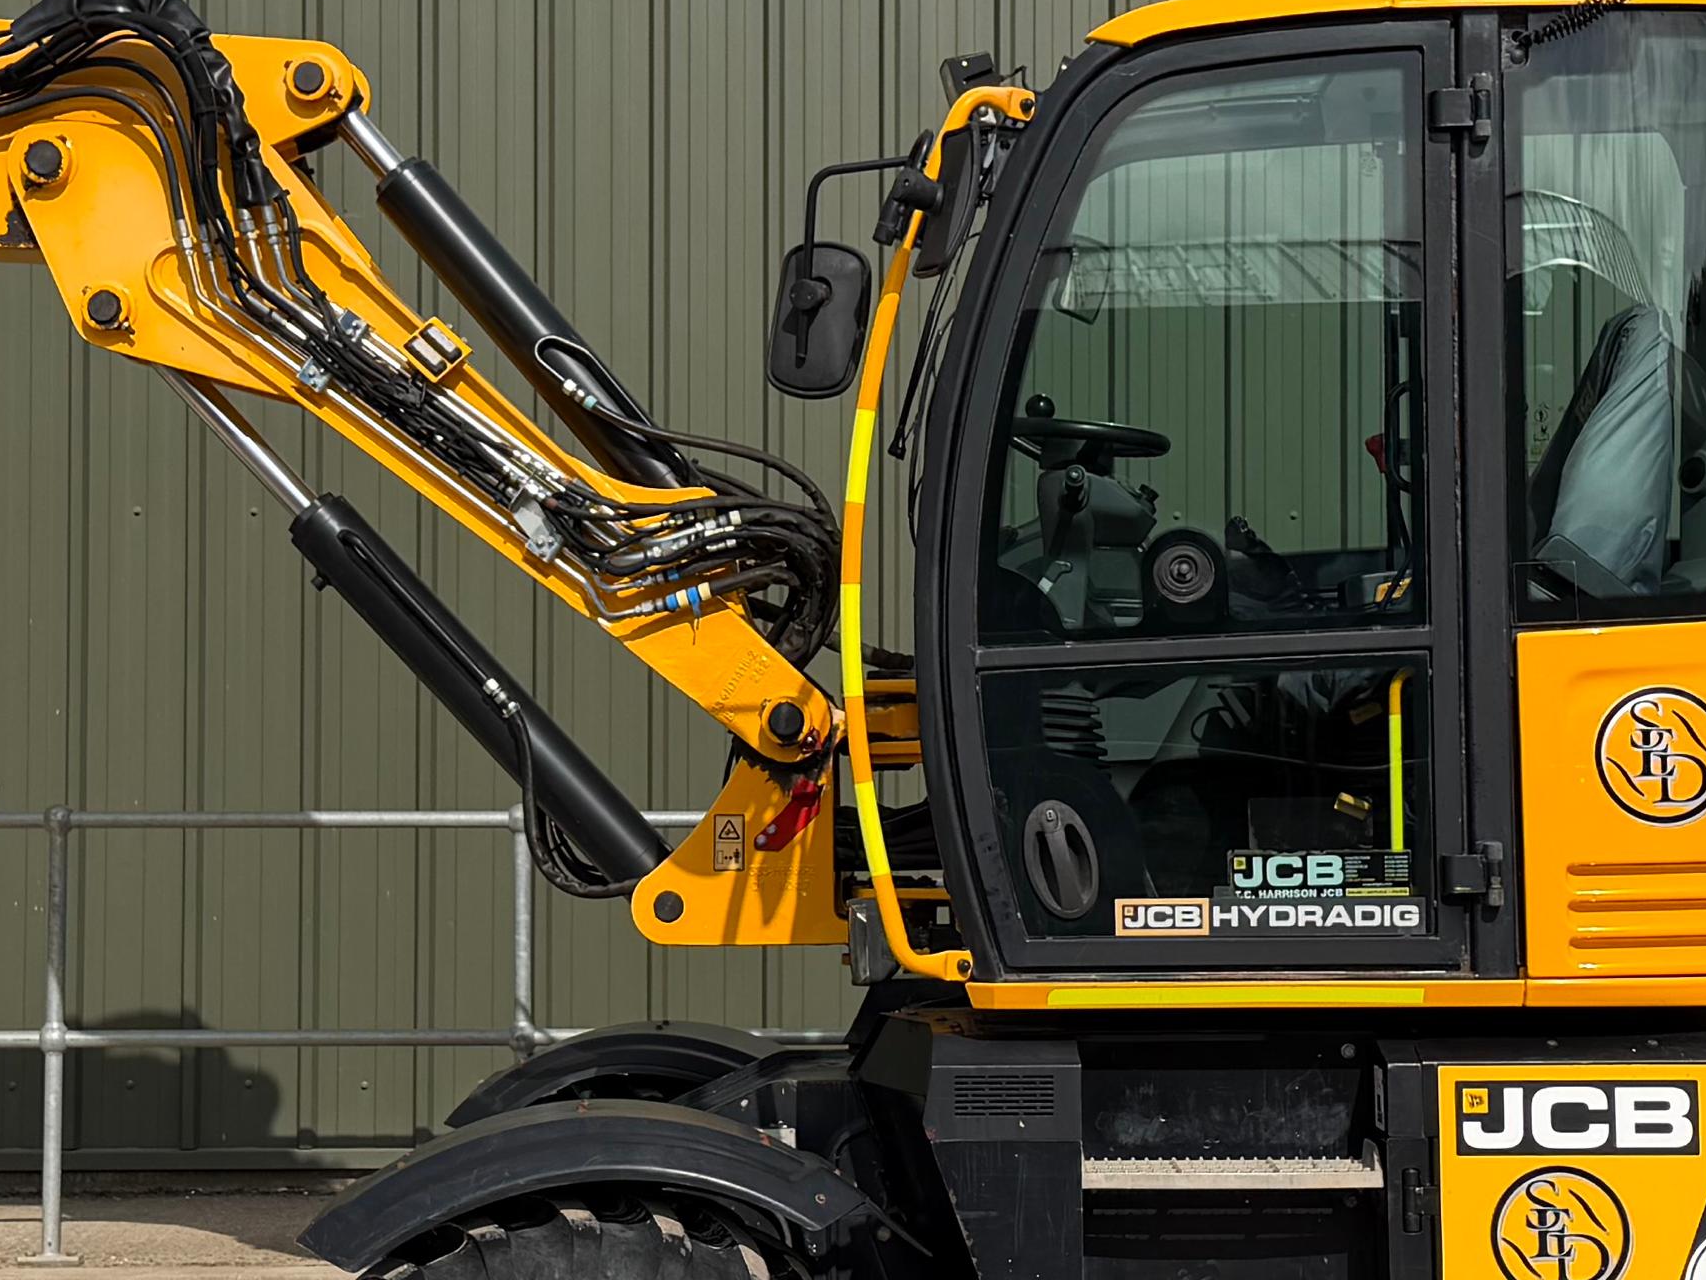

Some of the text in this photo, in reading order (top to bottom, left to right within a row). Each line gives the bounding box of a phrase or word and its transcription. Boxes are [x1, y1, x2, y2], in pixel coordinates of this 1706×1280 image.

[1234, 855, 1344, 888] JCB
[1258, 888, 1317, 899] HARRISON
[1320, 887, 1343, 898] JCB
[1124, 905, 1420, 928] JCB HYDRADIG
[1462, 1086, 1692, 1150] JCB
